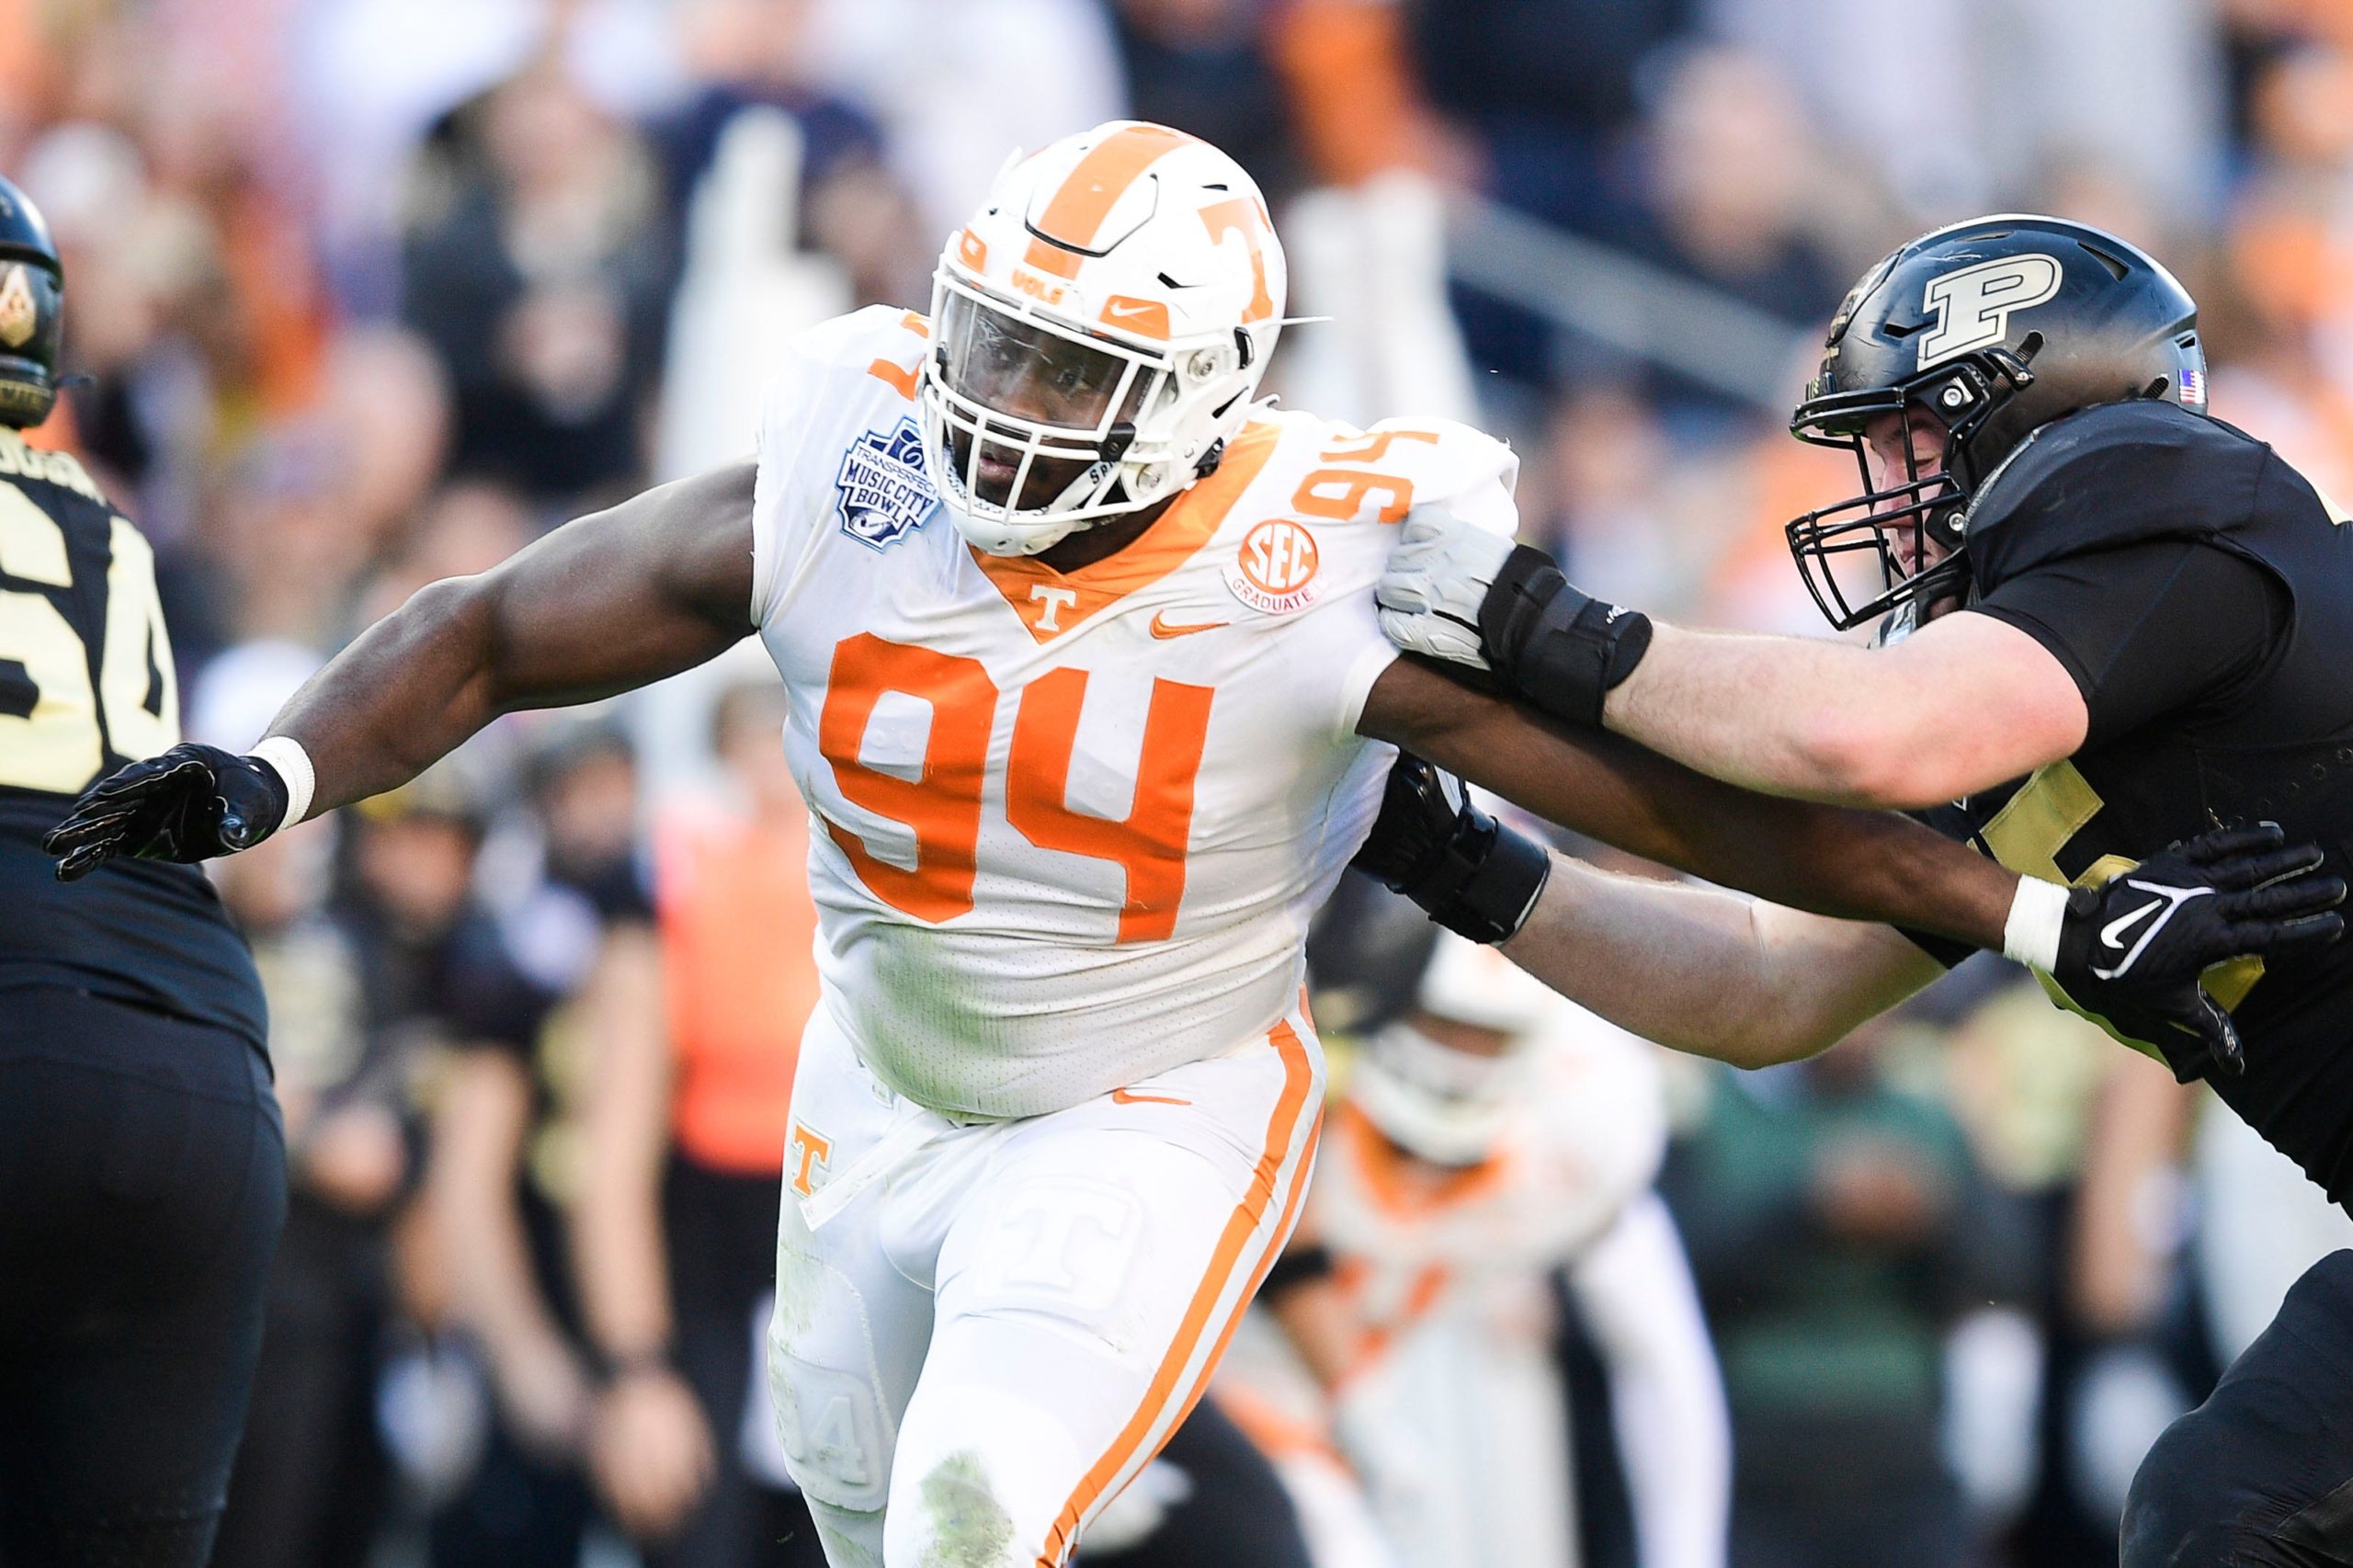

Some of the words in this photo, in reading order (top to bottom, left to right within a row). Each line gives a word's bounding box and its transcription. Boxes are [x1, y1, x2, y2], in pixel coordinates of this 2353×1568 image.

[1012, 268, 1064, 305] VOLS
[1197, 196, 1273, 324] T
[1917, 253, 2063, 372] P
[844, 459, 896, 495] MUSIC
[893, 483, 936, 518] CITY
[854, 487, 904, 524] BOWL
[1290, 430, 1440, 525] 94
[1245, 522, 1313, 589] SEC
[1030, 584, 1076, 632] T
[1232, 577, 1314, 612] GRADUATE
[819, 631, 1216, 945] 94
[793, 1123, 829, 1199] T
